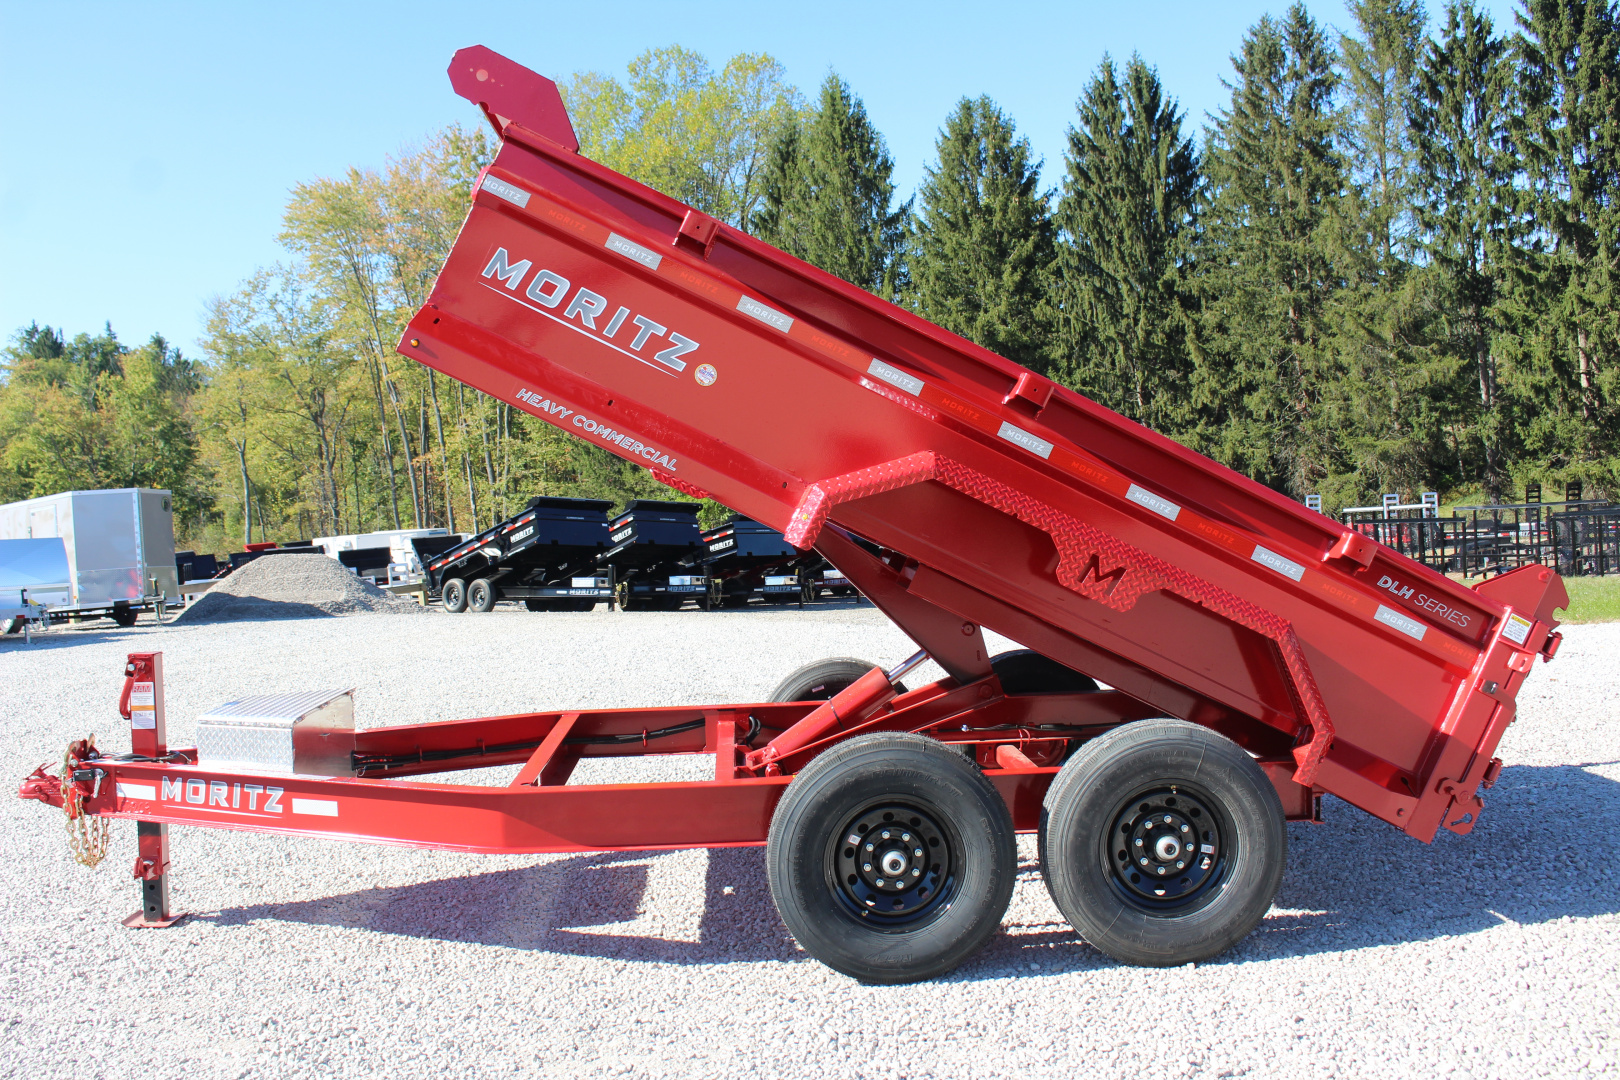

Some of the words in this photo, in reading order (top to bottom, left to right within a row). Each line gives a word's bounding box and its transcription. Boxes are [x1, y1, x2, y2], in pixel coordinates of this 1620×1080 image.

[483, 180, 522, 201] MORITZ
[548, 210, 587, 231] MORITZ
[613, 240, 652, 261] MORITZ
[680, 272, 719, 293] MORITZ
[481, 246, 700, 372] MORITZ
[745, 303, 784, 326] MORITZ
[811, 335, 850, 357] MORITZ
[876, 366, 915, 388] MORITZ
[942, 398, 980, 420] MORITZ
[516, 388, 574, 419] HEAVY
[572, 414, 678, 472] COMMERCIAL
[1006, 430, 1045, 451] MORITZ
[1071, 461, 1109, 483] MORITZ
[1134, 491, 1172, 513] MORITZ
[510, 526, 534, 543] MORITZ
[1197, 522, 1235, 543] MORITZ
[709, 539, 734, 552] MORITZ
[1079, 553, 1128, 597] M
[1260, 553, 1297, 575] MORITZ
[1322, 583, 1359, 605] MORITZ
[1377, 575, 1415, 600] DLH
[1413, 593, 1471, 628] SERIES
[1382, 612, 1419, 633] MORITZ
[161, 776, 285, 813] MORITZ
